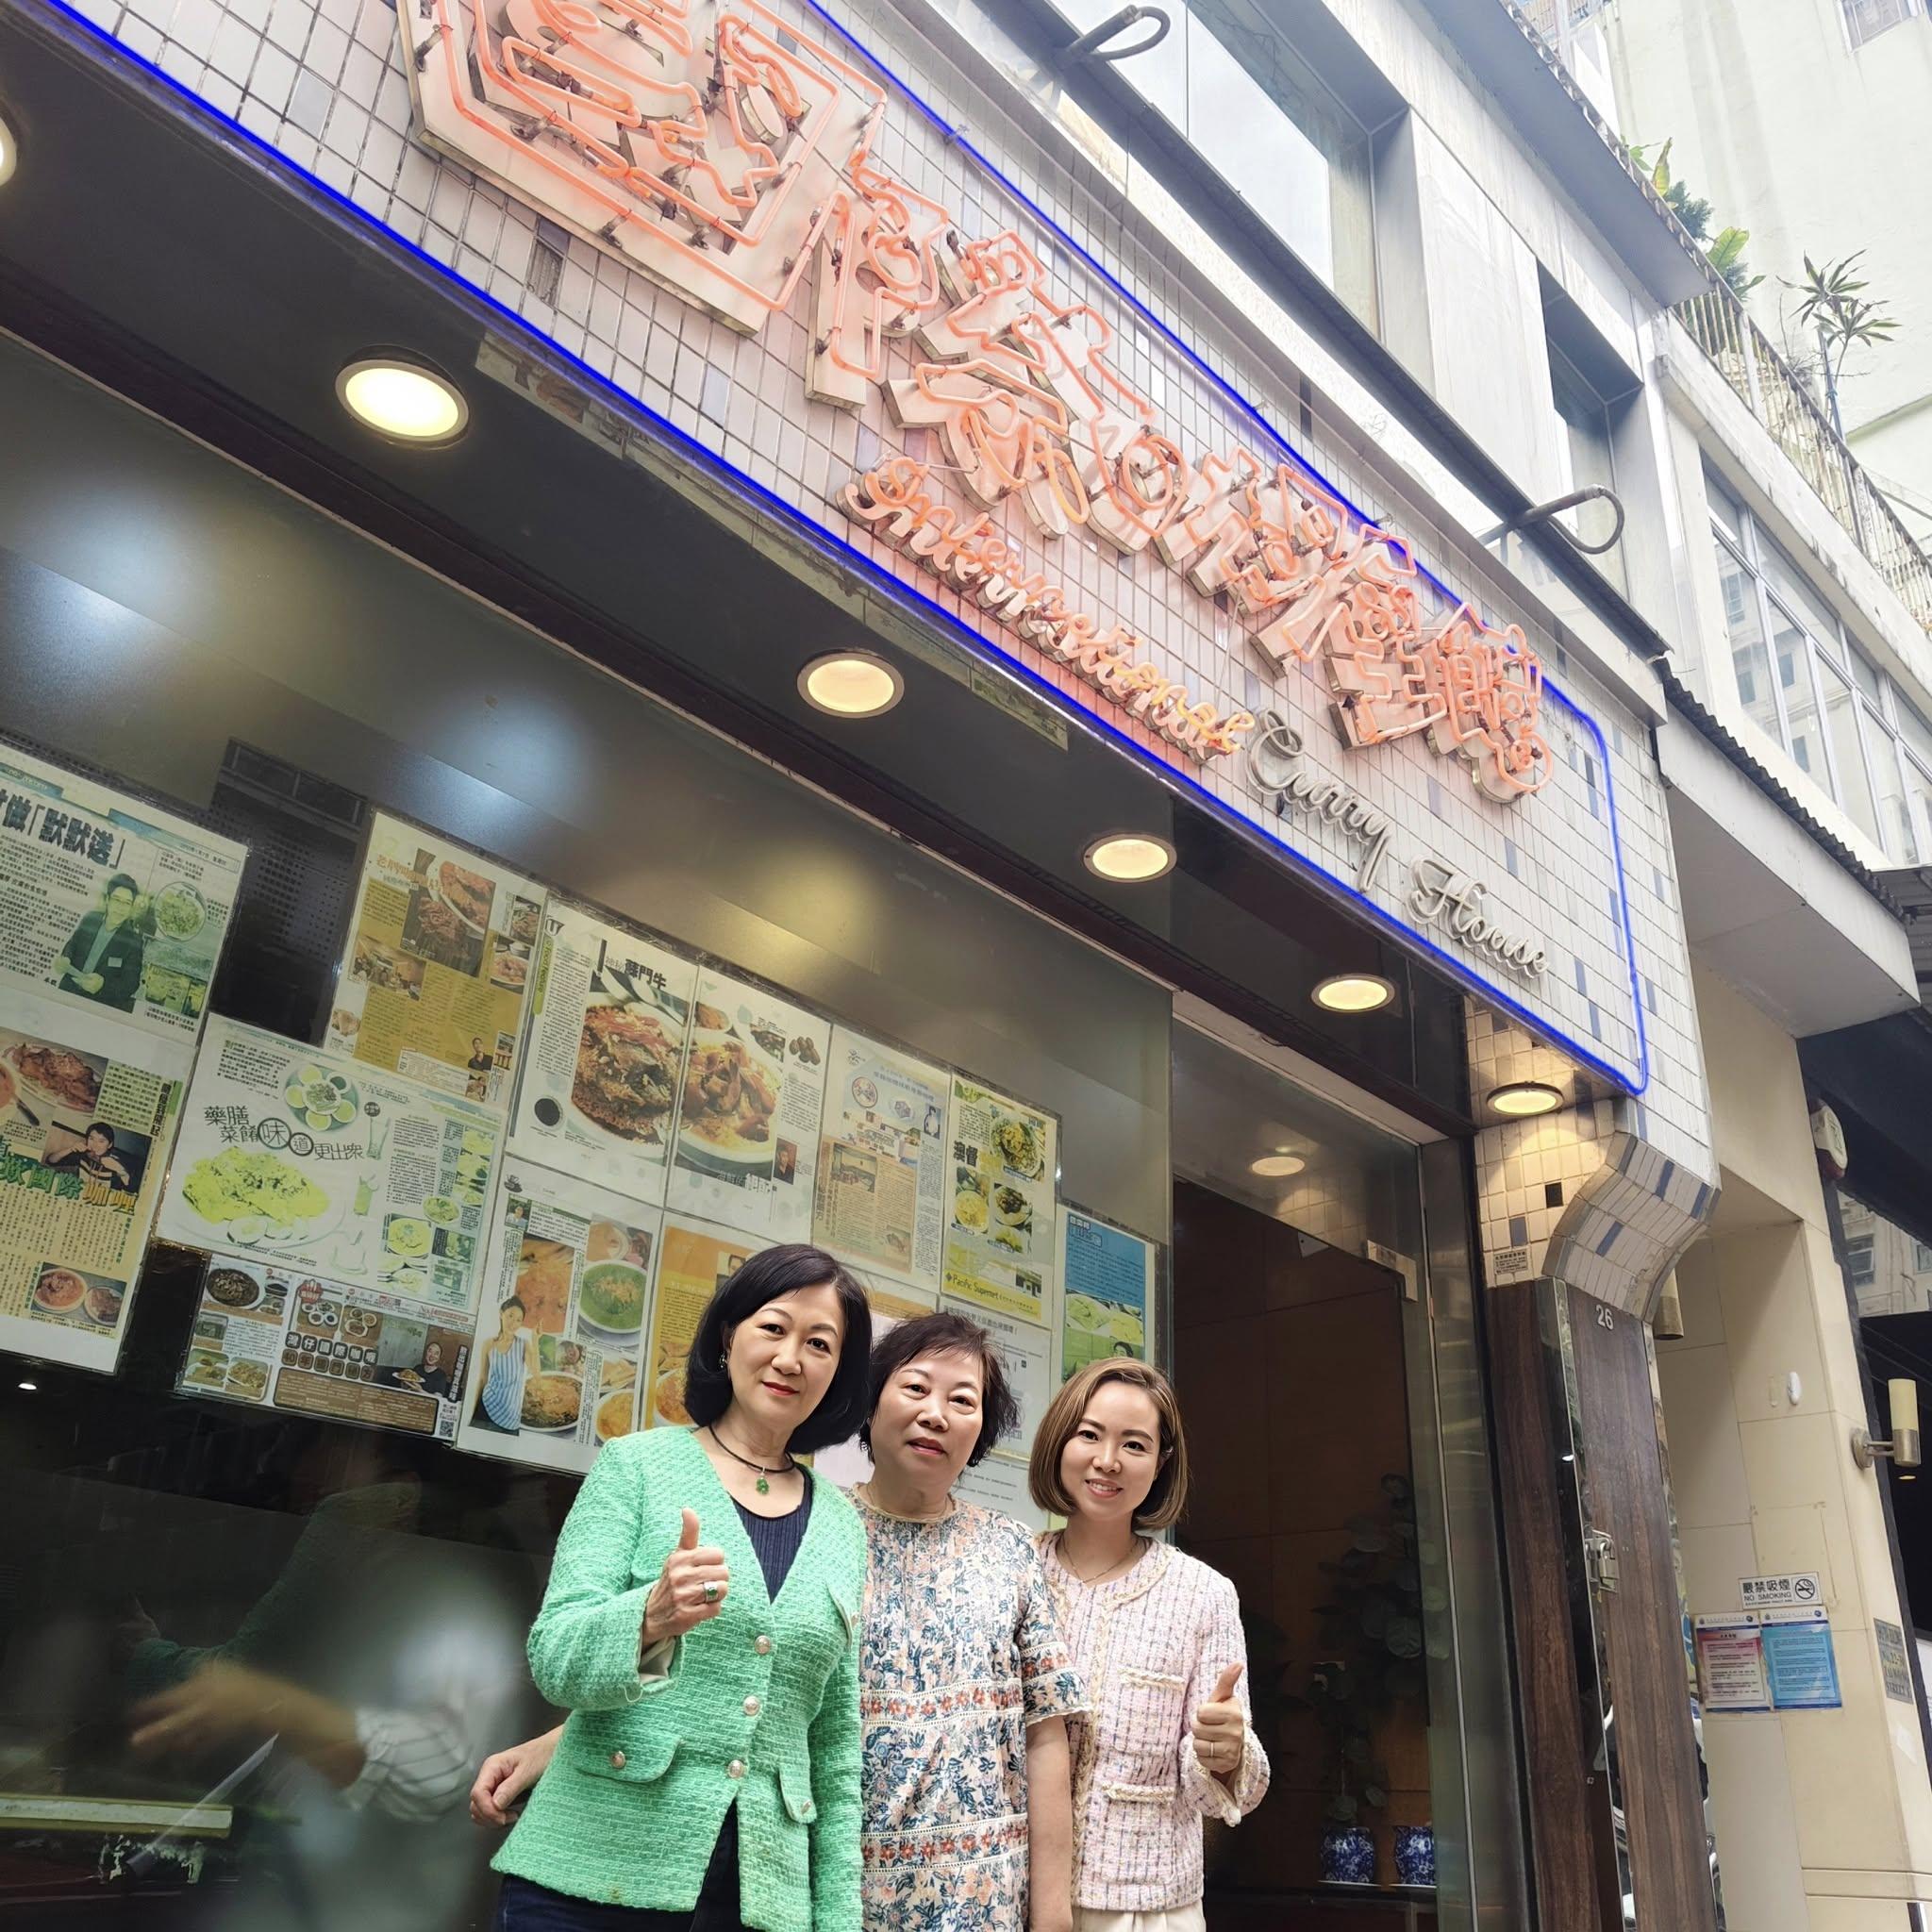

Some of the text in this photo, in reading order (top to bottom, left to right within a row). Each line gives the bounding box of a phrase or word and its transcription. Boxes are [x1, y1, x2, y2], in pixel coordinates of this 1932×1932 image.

[835, 456, 1549, 979] International Curry House
[204, 1106, 249, 1125] 藥膳
[1595, 1304, 1613, 1330] 26
[1743, 1591, 1792, 1602] NO SMOKING
